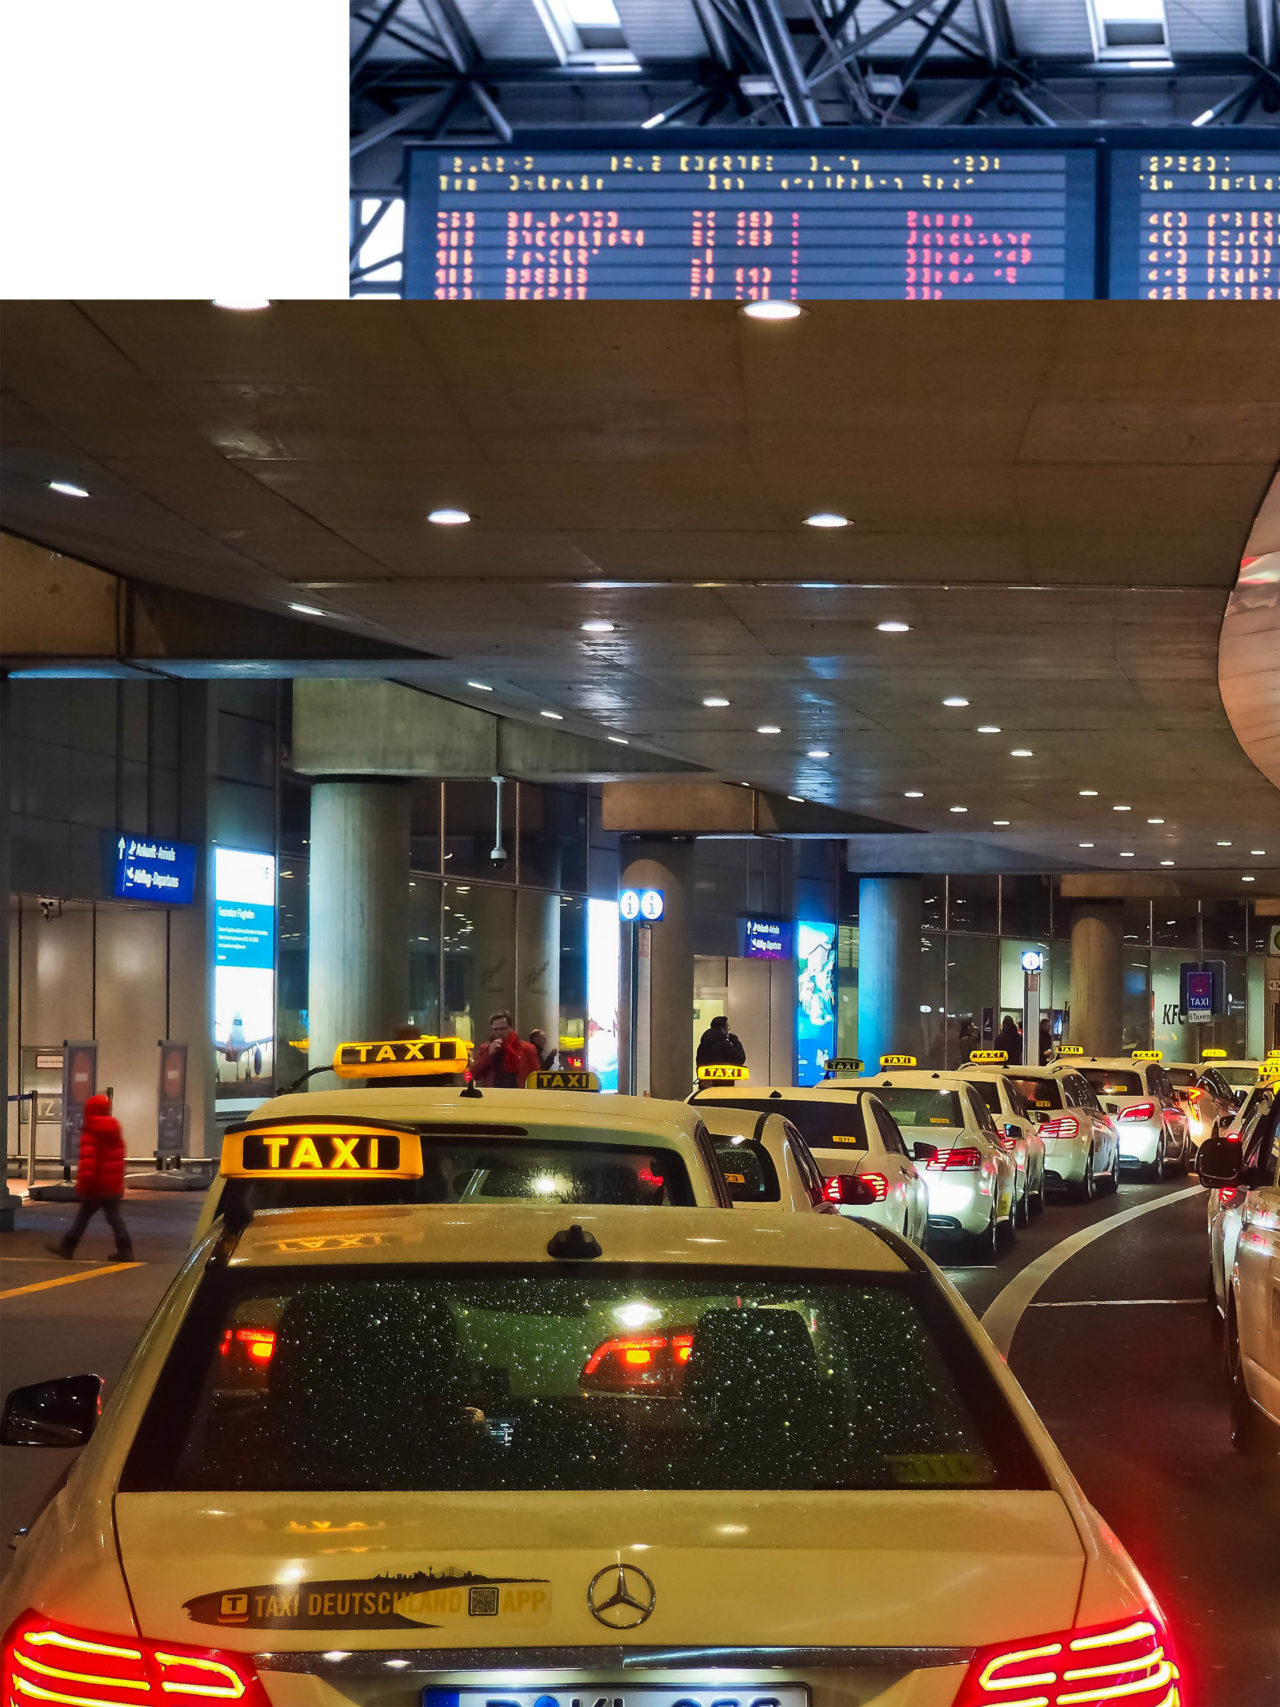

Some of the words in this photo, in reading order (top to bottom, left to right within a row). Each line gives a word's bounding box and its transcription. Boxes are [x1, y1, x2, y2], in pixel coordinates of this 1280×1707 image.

[1190, 997, 1209, 1006] TAXI
[354, 1042, 441, 1063] TAXI
[708, 1068, 739, 1078] TAXI
[832, 1062, 857, 1070] TAXI
[538, 1073, 590, 1089] TAXI
[262, 1137, 380, 1169] TAXI
[254, 1595, 300, 1617] TAXI
[307, 1590, 462, 1616] DEUTSCHLAND
[502, 1589, 546, 1614] APP
